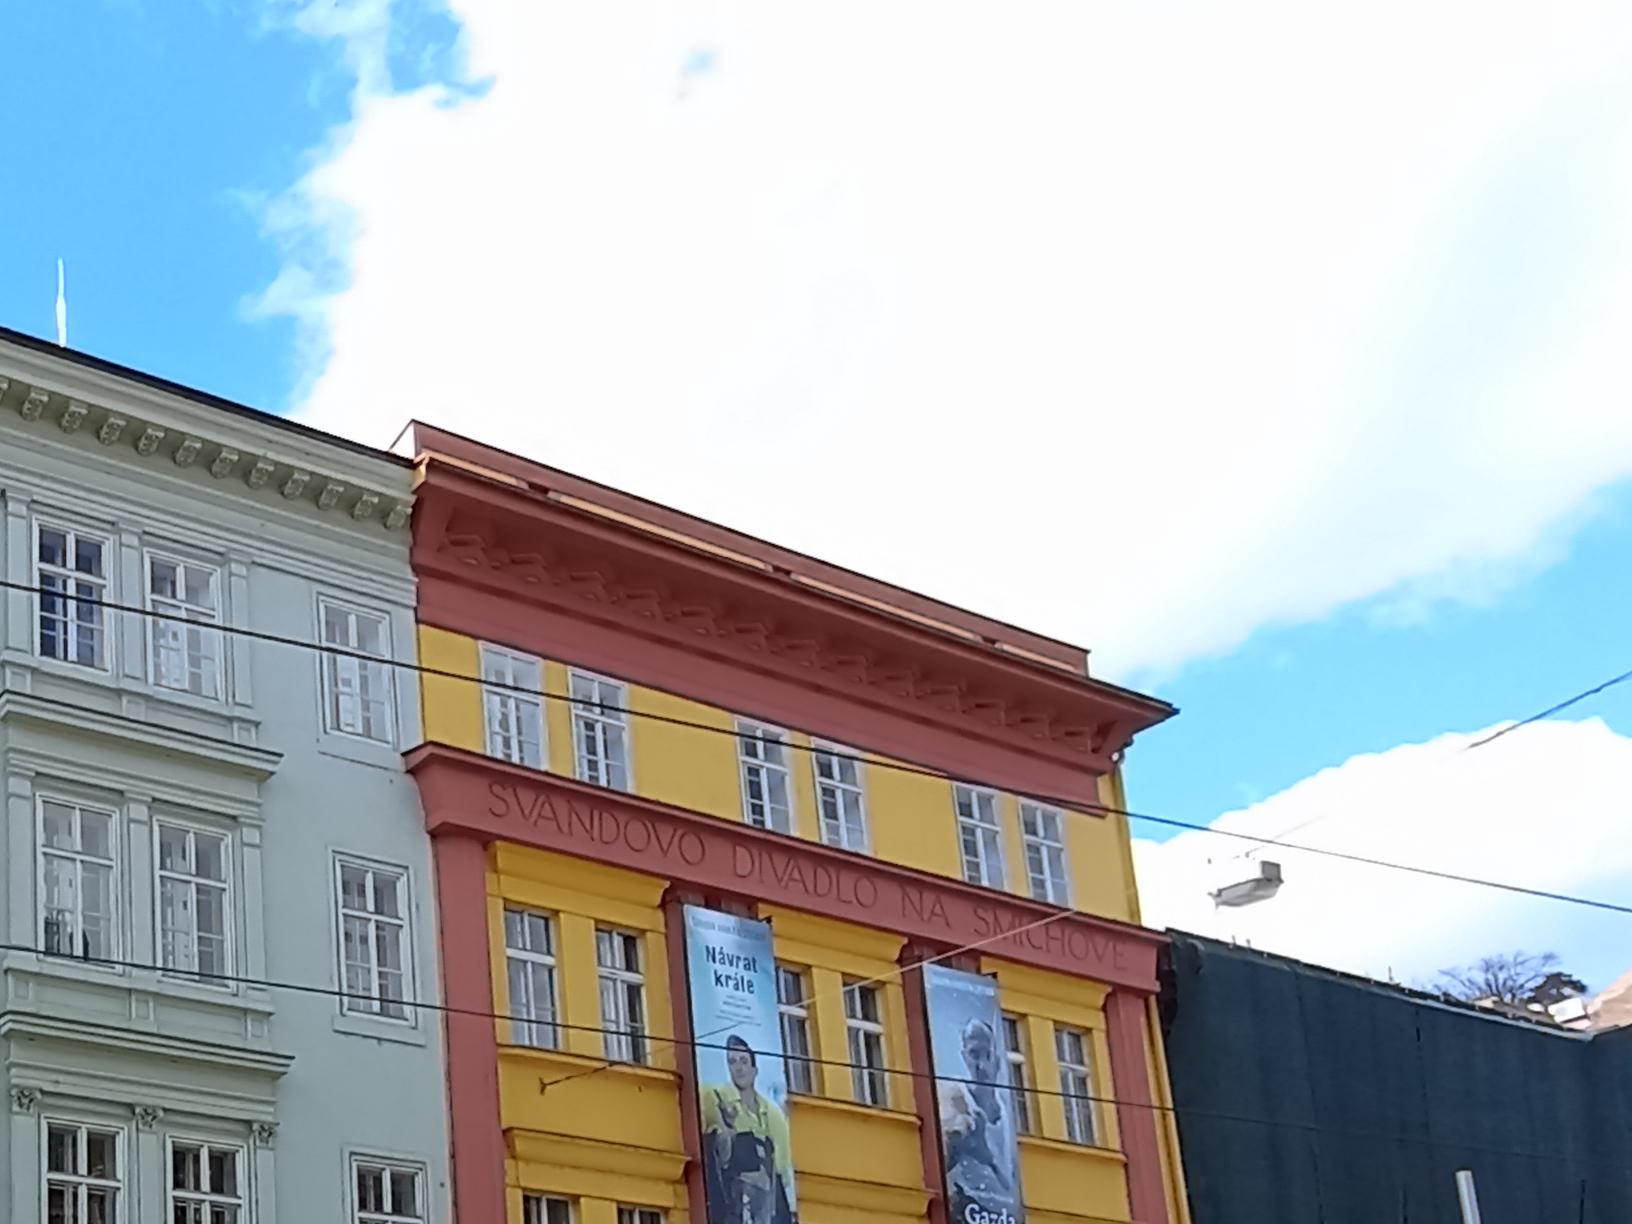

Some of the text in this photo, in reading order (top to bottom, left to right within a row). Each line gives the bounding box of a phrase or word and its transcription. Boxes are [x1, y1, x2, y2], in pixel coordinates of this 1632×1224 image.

[732, 843, 878, 908] DIVADLO
[898, 883, 951, 930] NA
[705, 944, 759, 974] Návrat
[714, 969, 756, 995] krále
